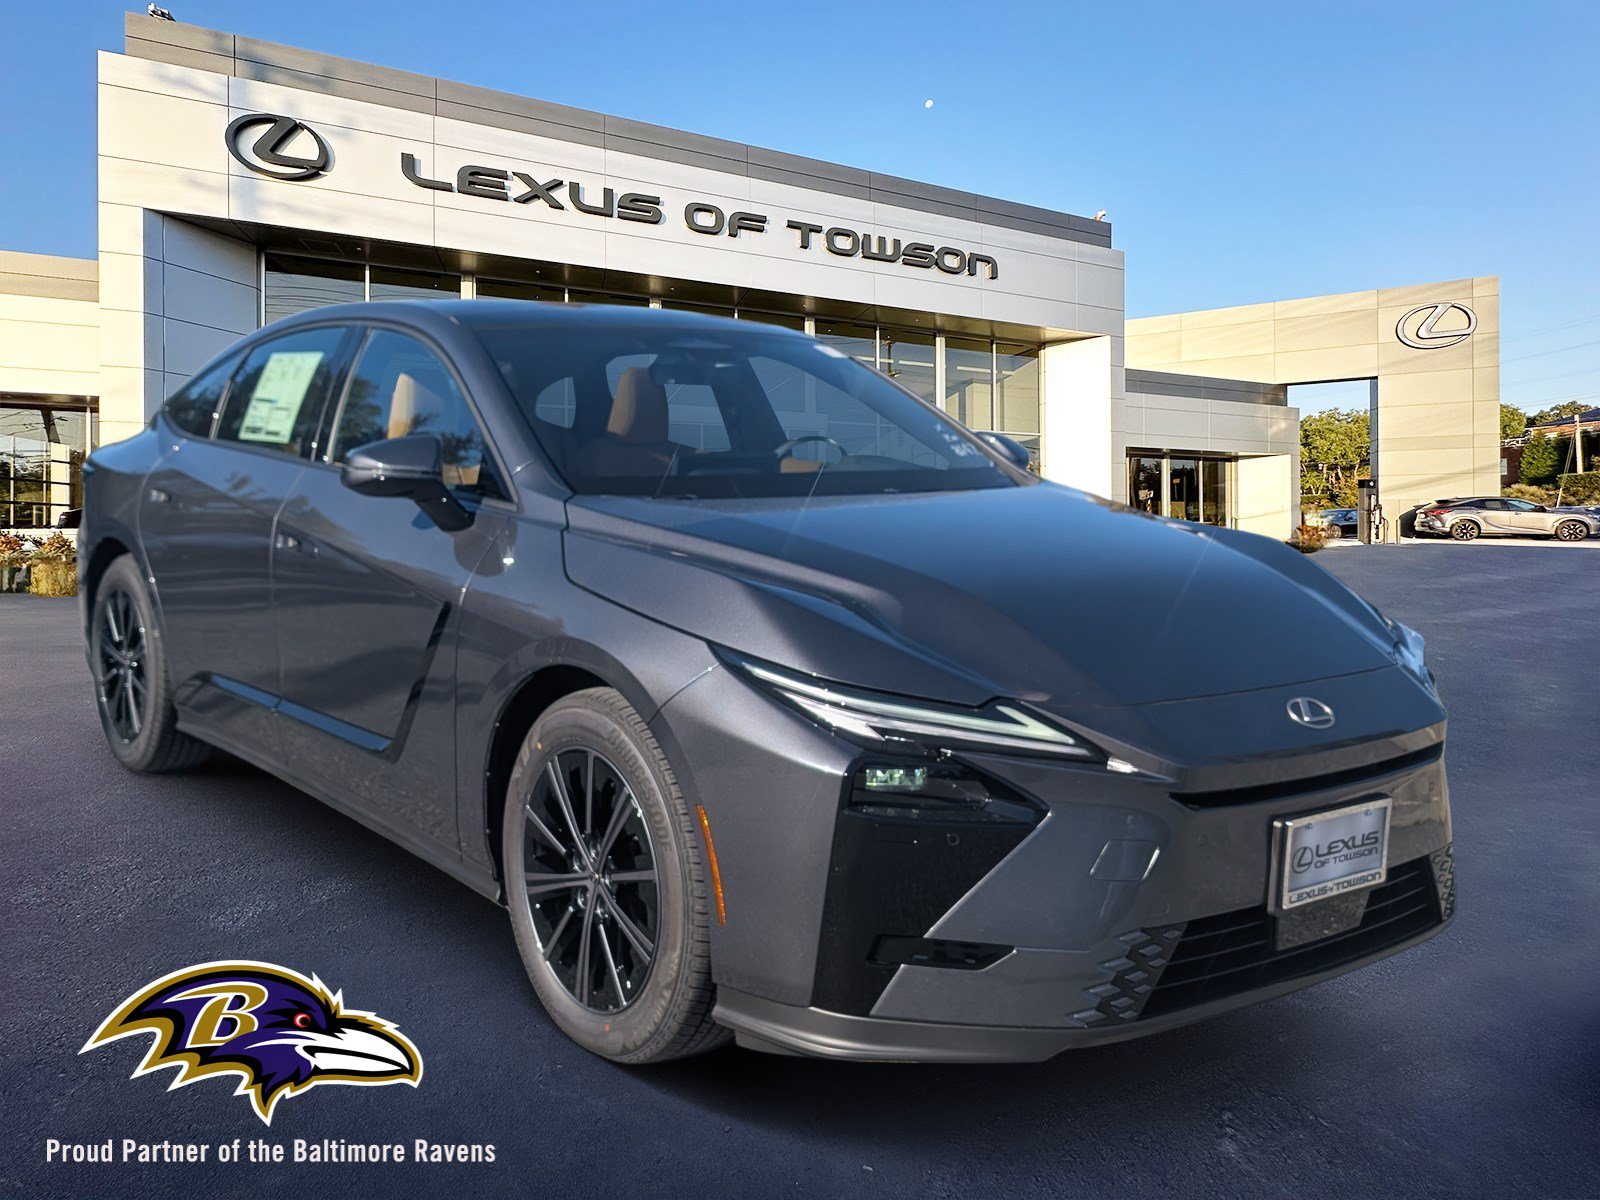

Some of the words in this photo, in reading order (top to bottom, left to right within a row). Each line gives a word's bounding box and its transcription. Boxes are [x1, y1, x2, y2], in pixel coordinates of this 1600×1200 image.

[400, 152, 664, 225] LEXUS
[684, 202, 768, 238] OF
[786, 219, 999, 281] TOWSON
[1314, 859, 1330, 869] OF
[1333, 846, 1378, 864] TOWSON
[1315, 831, 1379, 857] LEXUS
[1289, 886, 1328, 904] LEXUS
[1335, 871, 1381, 890] TOWSON
